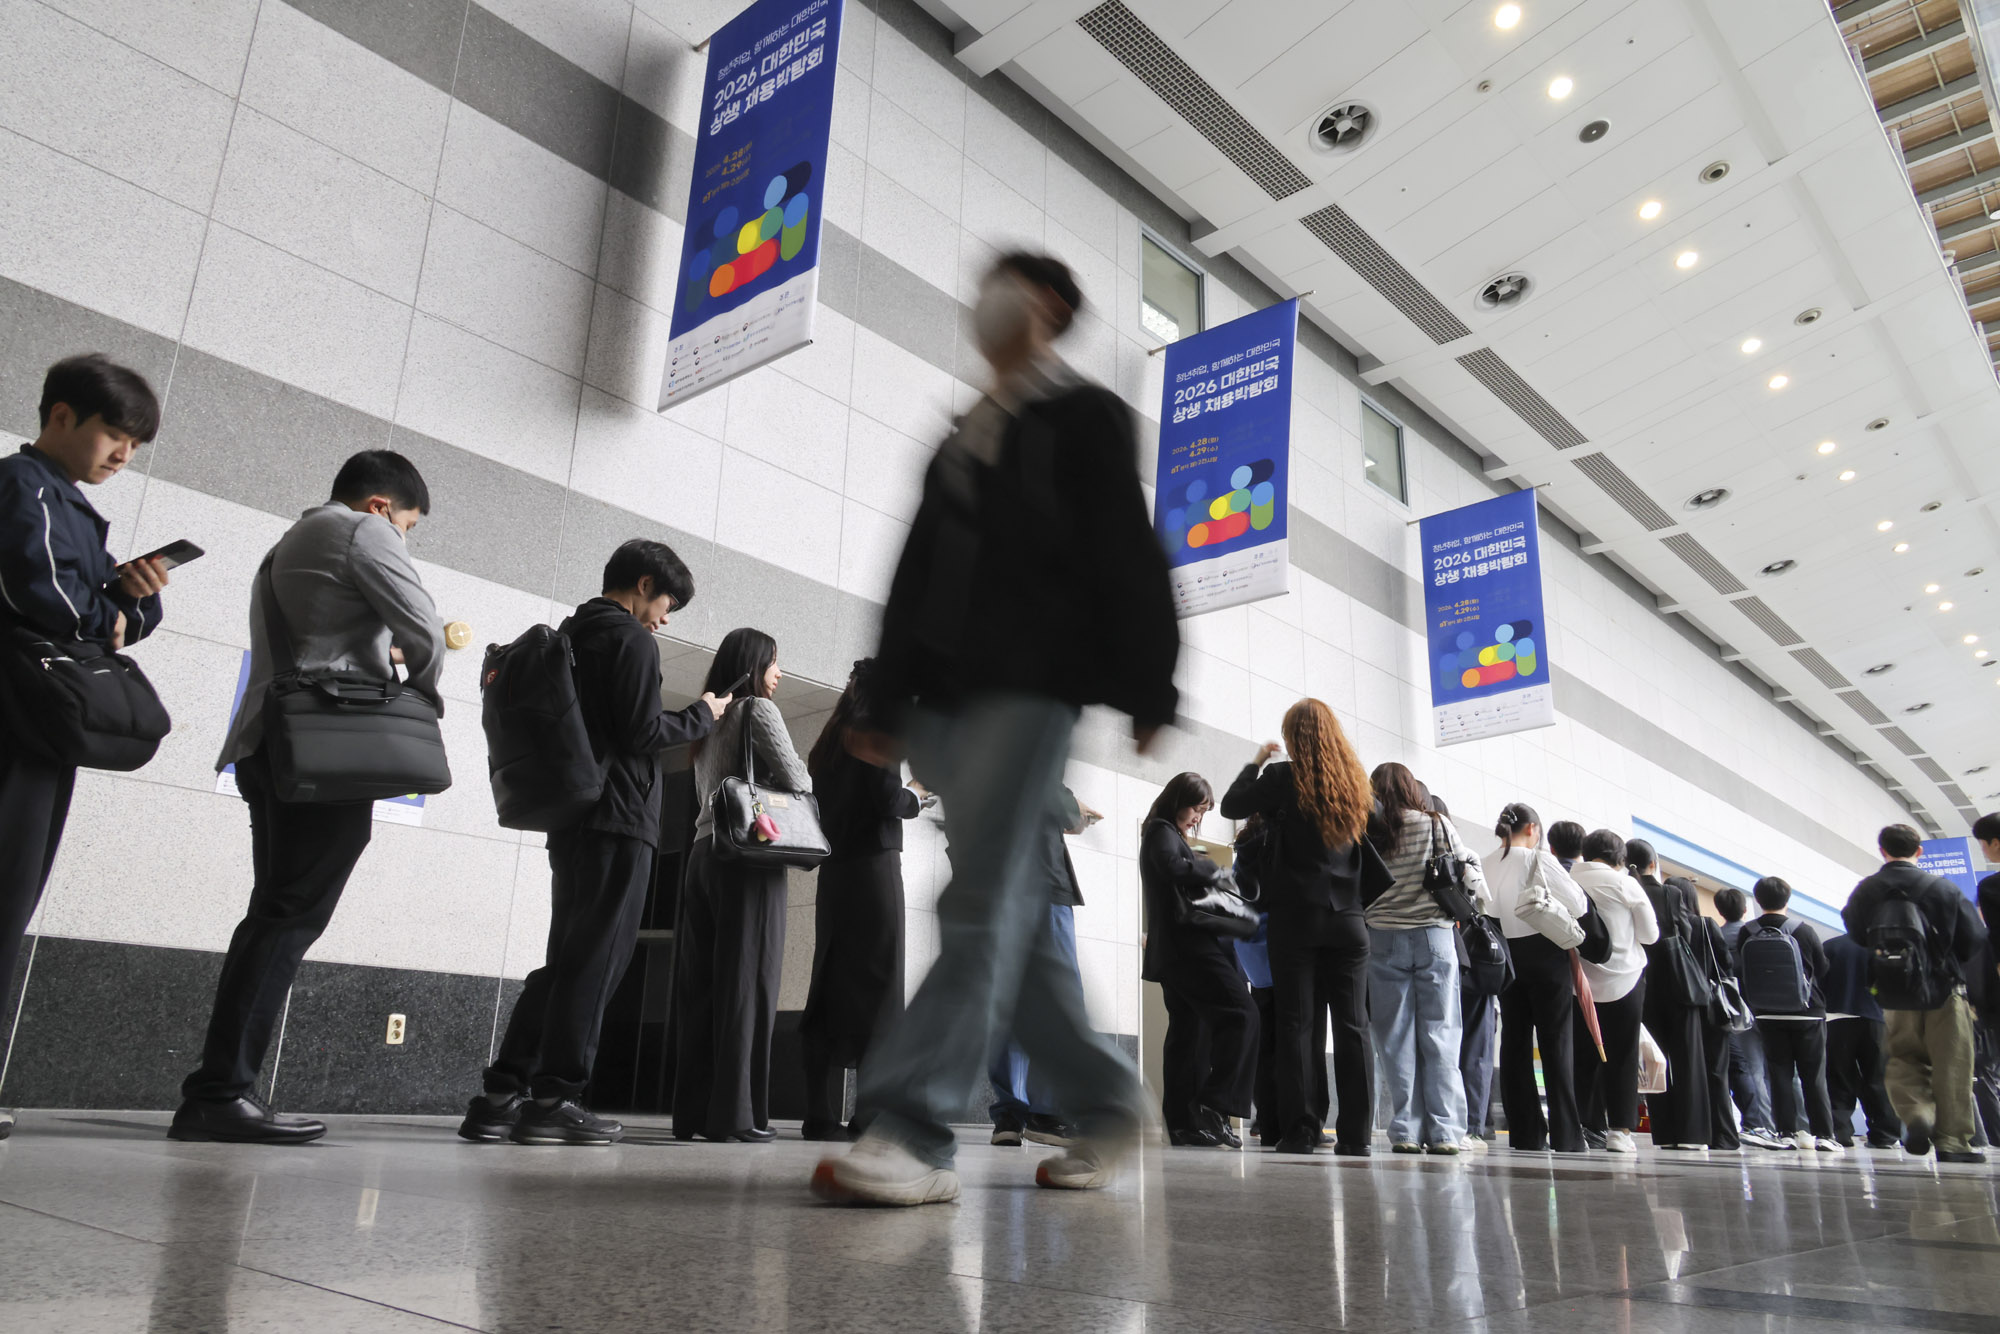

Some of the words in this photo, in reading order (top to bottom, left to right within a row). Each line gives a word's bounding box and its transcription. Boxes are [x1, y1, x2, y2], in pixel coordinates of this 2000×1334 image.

[754, 24, 790, 55] 함께하는
[713, 66, 757, 111] 2026
[760, 17, 827, 76] 대한민국
[710, 100, 741, 136] 상생
[744, 43, 824, 113] 채용박람회
[1211, 353, 1245, 372] 함께하는
[1246, 338, 1281, 358] 대한민국
[1174, 379, 1218, 405] 2026
[1220, 355, 1280, 390] 대한민국
[1172, 400, 1201, 424] 상생
[1204, 374, 1279, 413] 채용박람회
[1463, 531, 1494, 545] 함께하는
[1494, 521, 1525, 537] 대한민국
[1433, 551, 1471, 571] 2026
[1474, 536, 1527, 561] 대한민국
[1434, 569, 1461, 587] 상생
[1462, 551, 1528, 579] 채용박람회
[1916, 861, 1934, 869] 026
